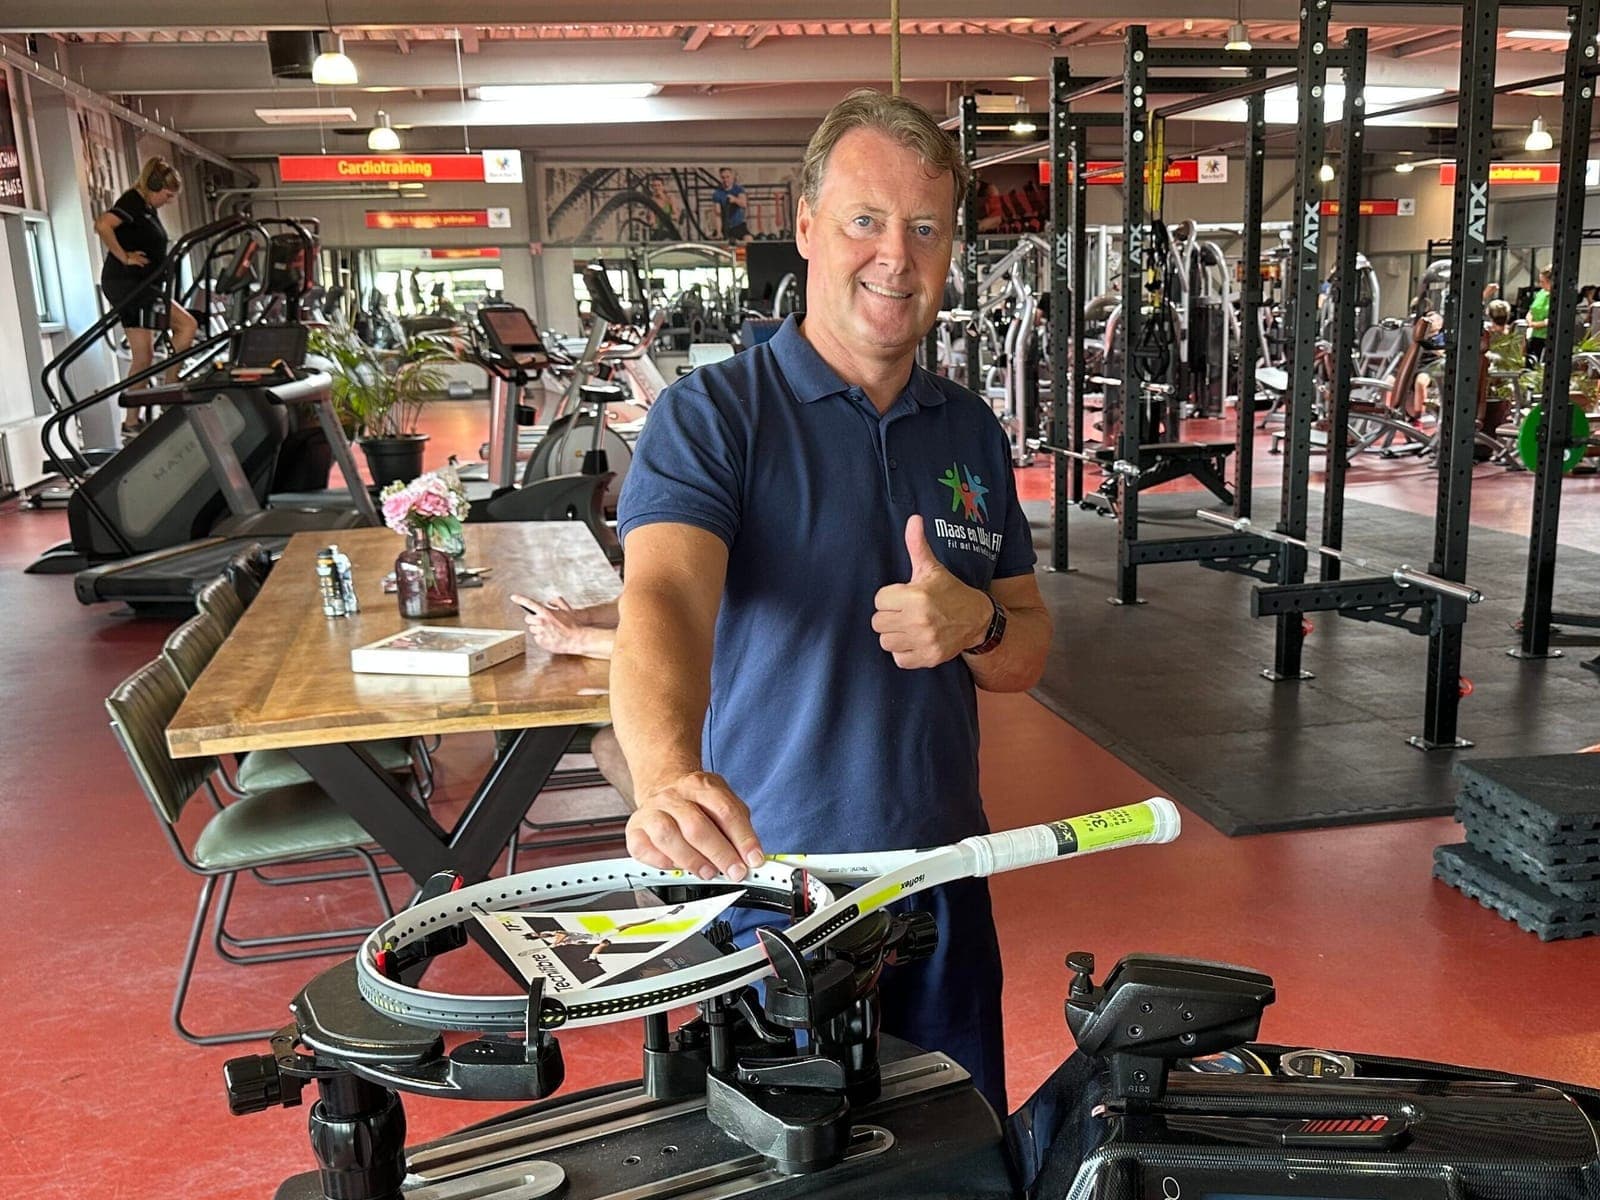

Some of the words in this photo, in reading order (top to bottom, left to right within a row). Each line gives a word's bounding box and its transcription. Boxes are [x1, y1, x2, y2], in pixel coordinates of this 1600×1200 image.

[338, 160, 432, 177] Cardiotraining
[1303, 201, 1320, 254] ATX
[1469, 181, 1488, 243] ATX
[967, 243, 978, 273] ATX
[1056, 232, 1067, 268] ATX
[1129, 223, 1142, 264] ATX
[935, 519, 967, 539] Maas
[900, 874, 925, 890] isoflex
[532, 953, 574, 993] Tecnifibre
